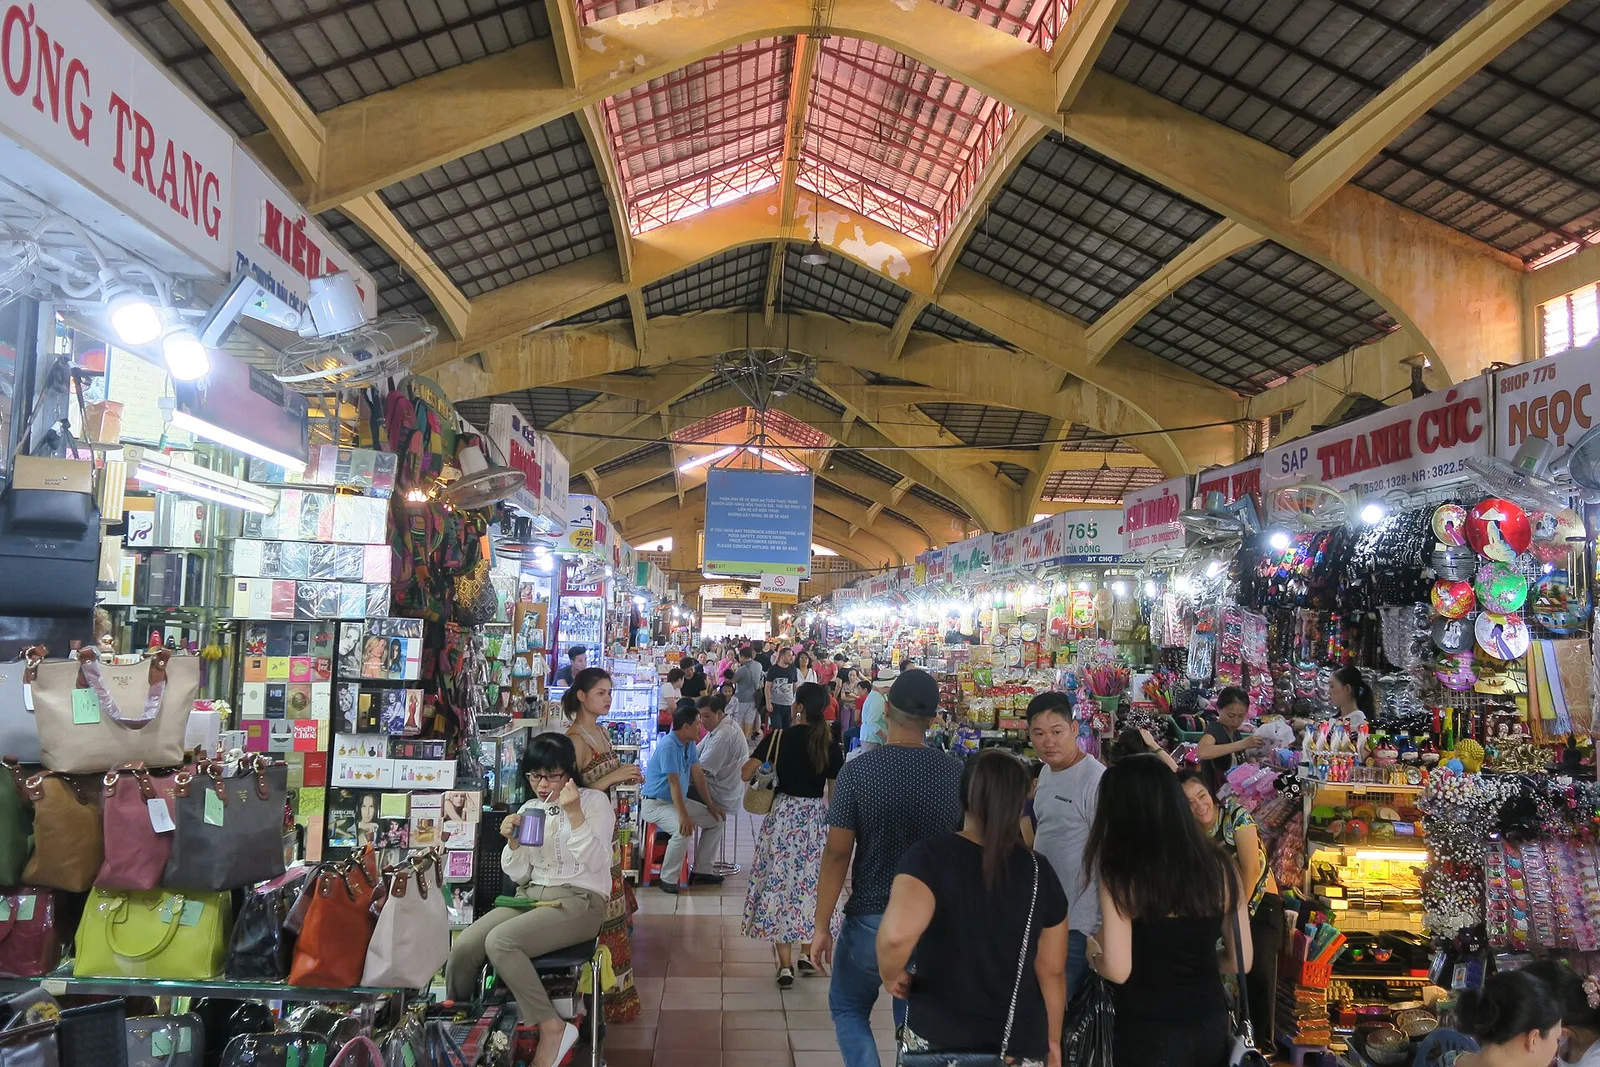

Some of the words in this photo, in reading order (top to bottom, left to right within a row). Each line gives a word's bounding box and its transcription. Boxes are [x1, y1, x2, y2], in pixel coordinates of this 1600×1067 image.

[109, 91, 222, 242] TRANG
[1500, 371, 1529, 394] SHOP
[1533, 363, 1556, 385] 775
[1508, 383, 1592, 447] NGỌC
[1281, 447, 1308, 476] SẠP
[1317, 418, 1413, 481] THANH
[1417, 389, 1483, 454] CÚC
[1432, 458, 1469, 478] 3822.5
[1067, 523, 1098, 541] 765
[254, 588, 266, 600] ck
[772, 586, 795, 594] SMOKING
